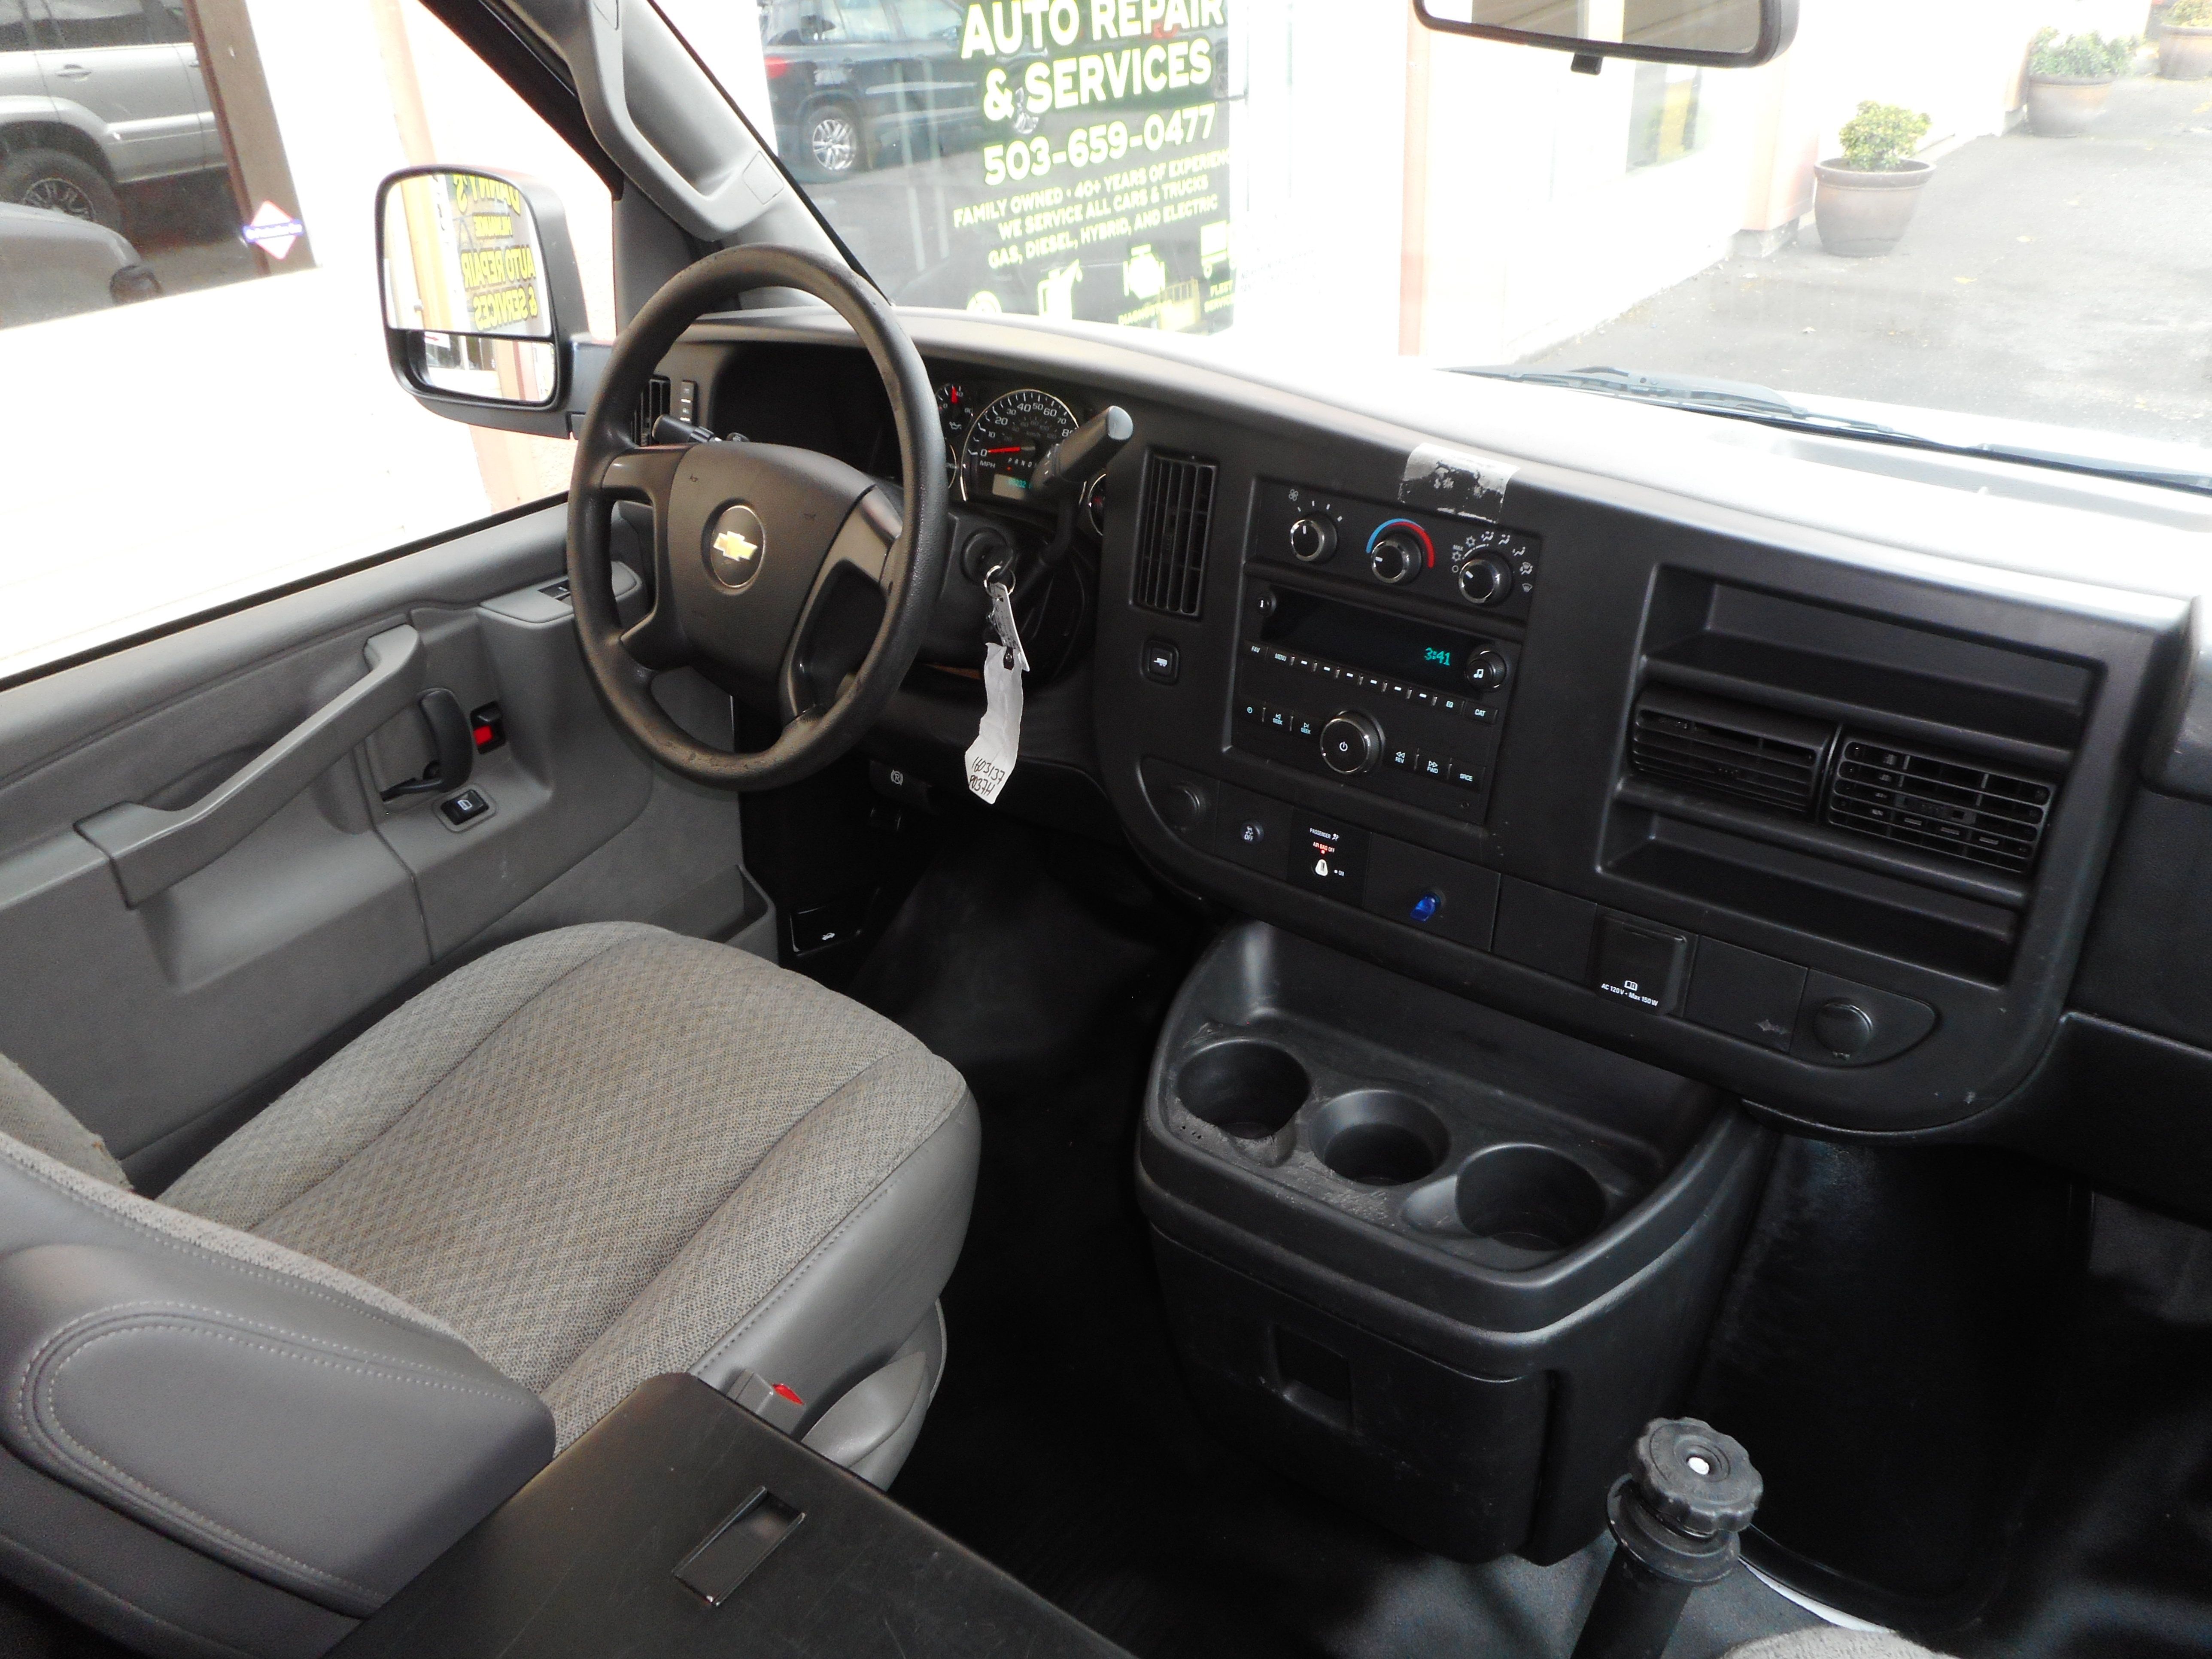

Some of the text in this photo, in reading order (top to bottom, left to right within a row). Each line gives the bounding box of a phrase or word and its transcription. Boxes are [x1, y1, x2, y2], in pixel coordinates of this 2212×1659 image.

[961, 0, 1224, 58] AUTO REPAIR
[983, 38, 1212, 121] & SERVICES
[984, 103, 1216, 186] 503-659-0477
[953, 148, 1230, 228] FAMILY OWNED 40+ YEARS OF EXPERIENC
[998, 174, 1209, 240] WE SERVICE ALL CARS & TRUCKS
[988, 194, 1218, 269] GAS, DIESEL, HYBRID, AND ELECTRIC
[1017, 403, 1031, 412] 40
[1033, 402, 1043, 410] 50
[1043, 408, 1057, 417] 60
[995, 416, 1008, 425] 20
[1061, 428, 1073, 437] 8
[981, 449, 988, 457] 0
[1274, 653, 1287, 662] MENU
[1424, 647, 1451, 665] 3:41
[1427, 766, 1438, 774] FWD
[1310, 828, 1331, 839] PASSENGER
[1629, 992, 1640, 1001] Max
